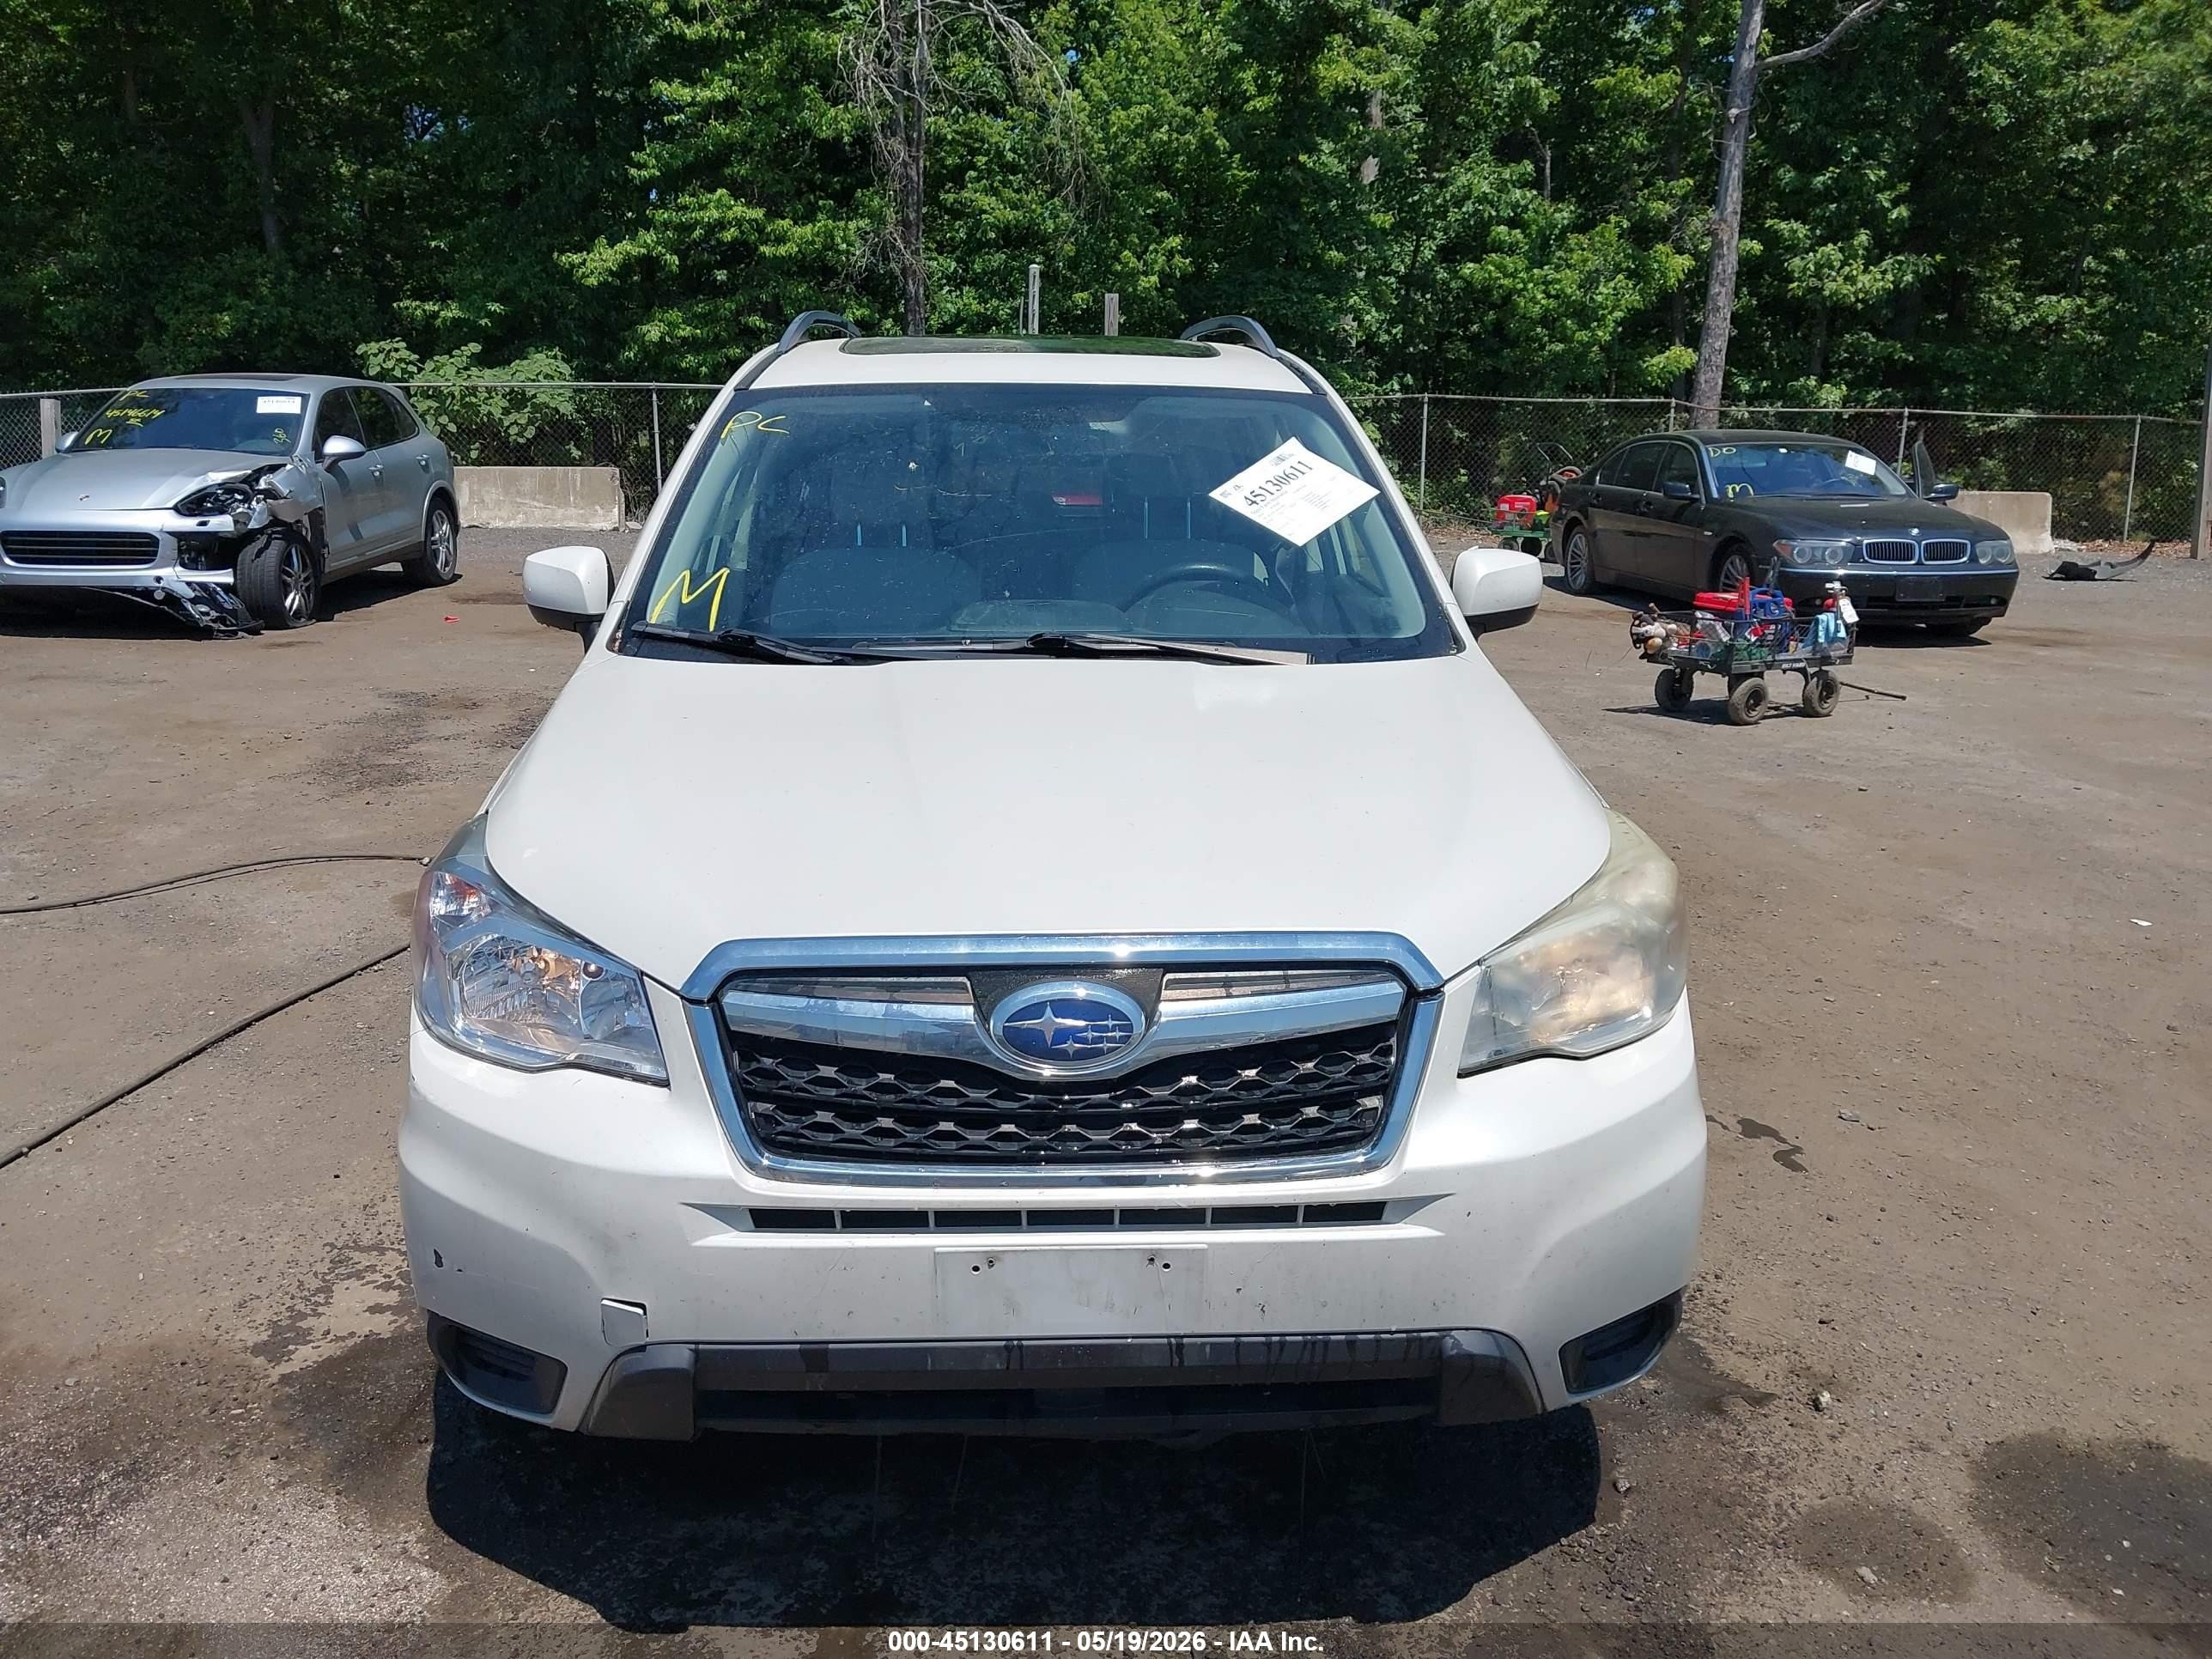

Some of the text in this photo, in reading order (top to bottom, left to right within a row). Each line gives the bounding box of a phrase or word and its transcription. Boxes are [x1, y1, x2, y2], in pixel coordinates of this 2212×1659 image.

[720, 411, 789, 439] PC
[1243, 460, 1313, 507] 45130611
[649, 567, 730, 632] M
